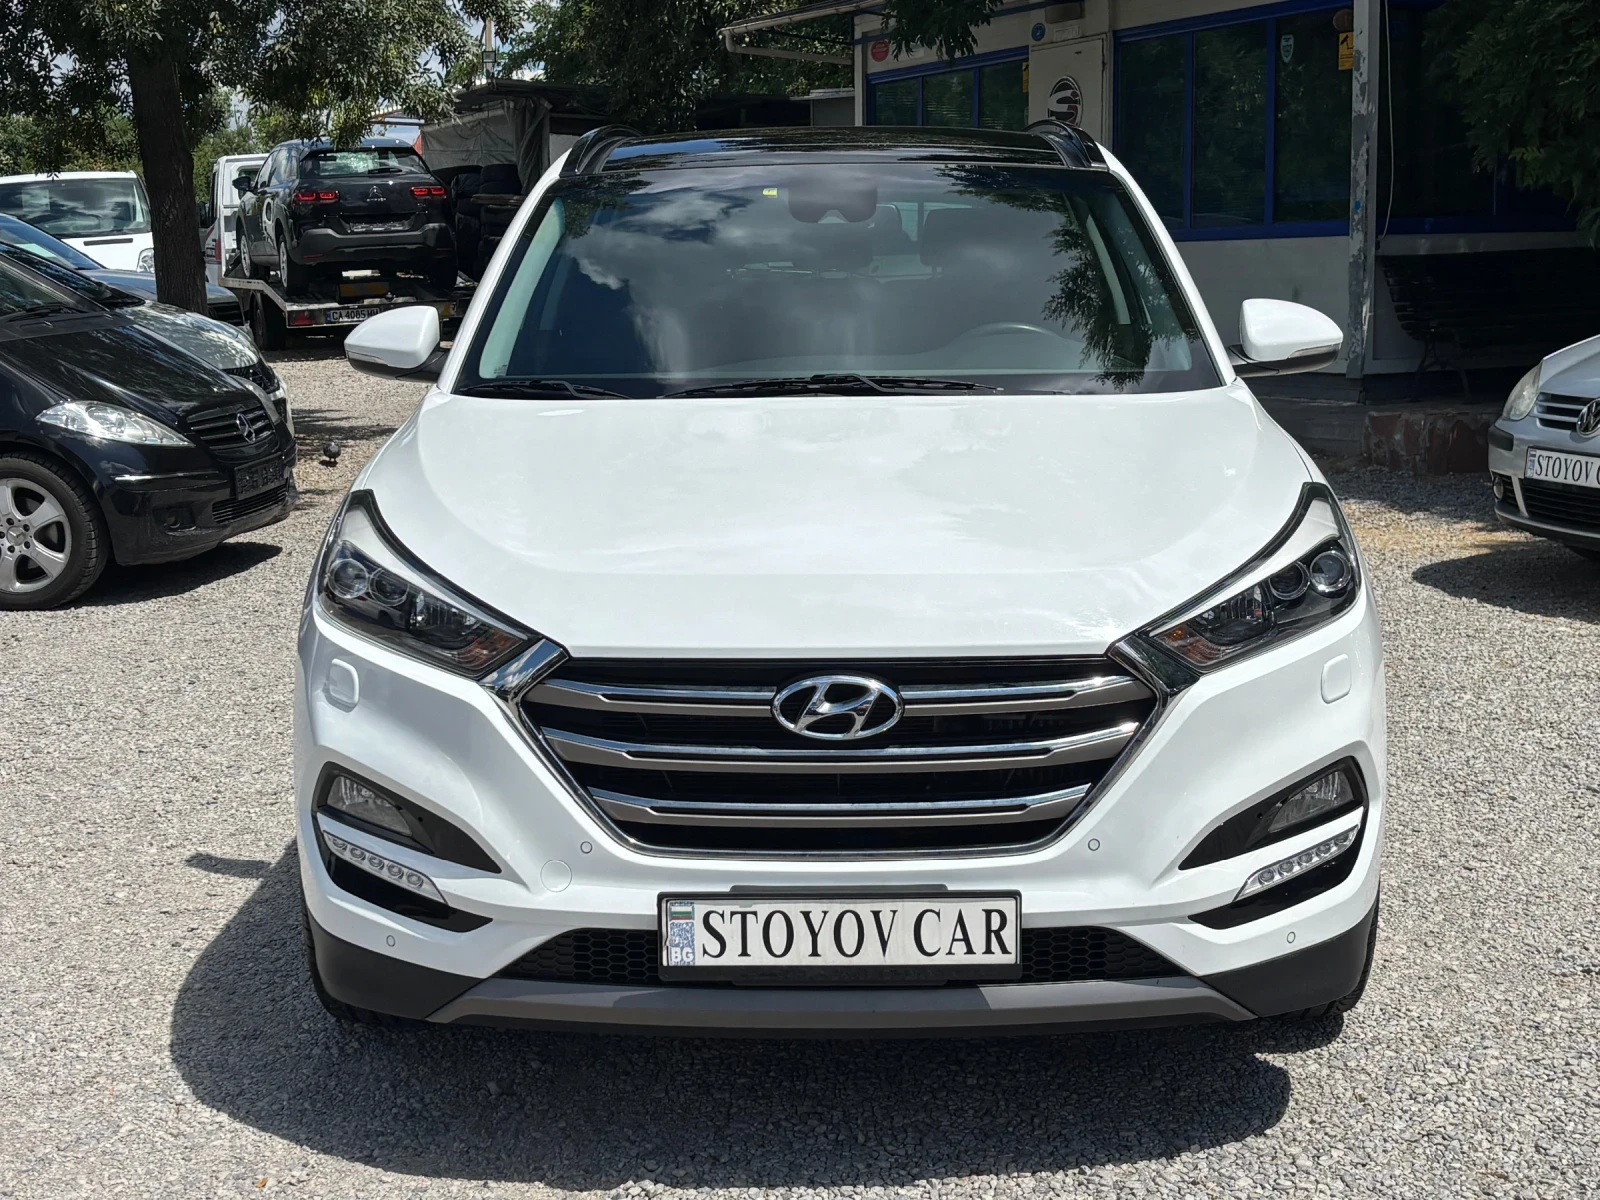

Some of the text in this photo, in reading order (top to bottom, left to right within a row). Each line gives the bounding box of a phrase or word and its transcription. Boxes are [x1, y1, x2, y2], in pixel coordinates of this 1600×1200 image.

[331, 311, 344, 320] CA
[1535, 454, 1594, 483] STOYOV
[702, 908, 1013, 959] STOYOV CAR
[671, 947, 694, 962] BG
